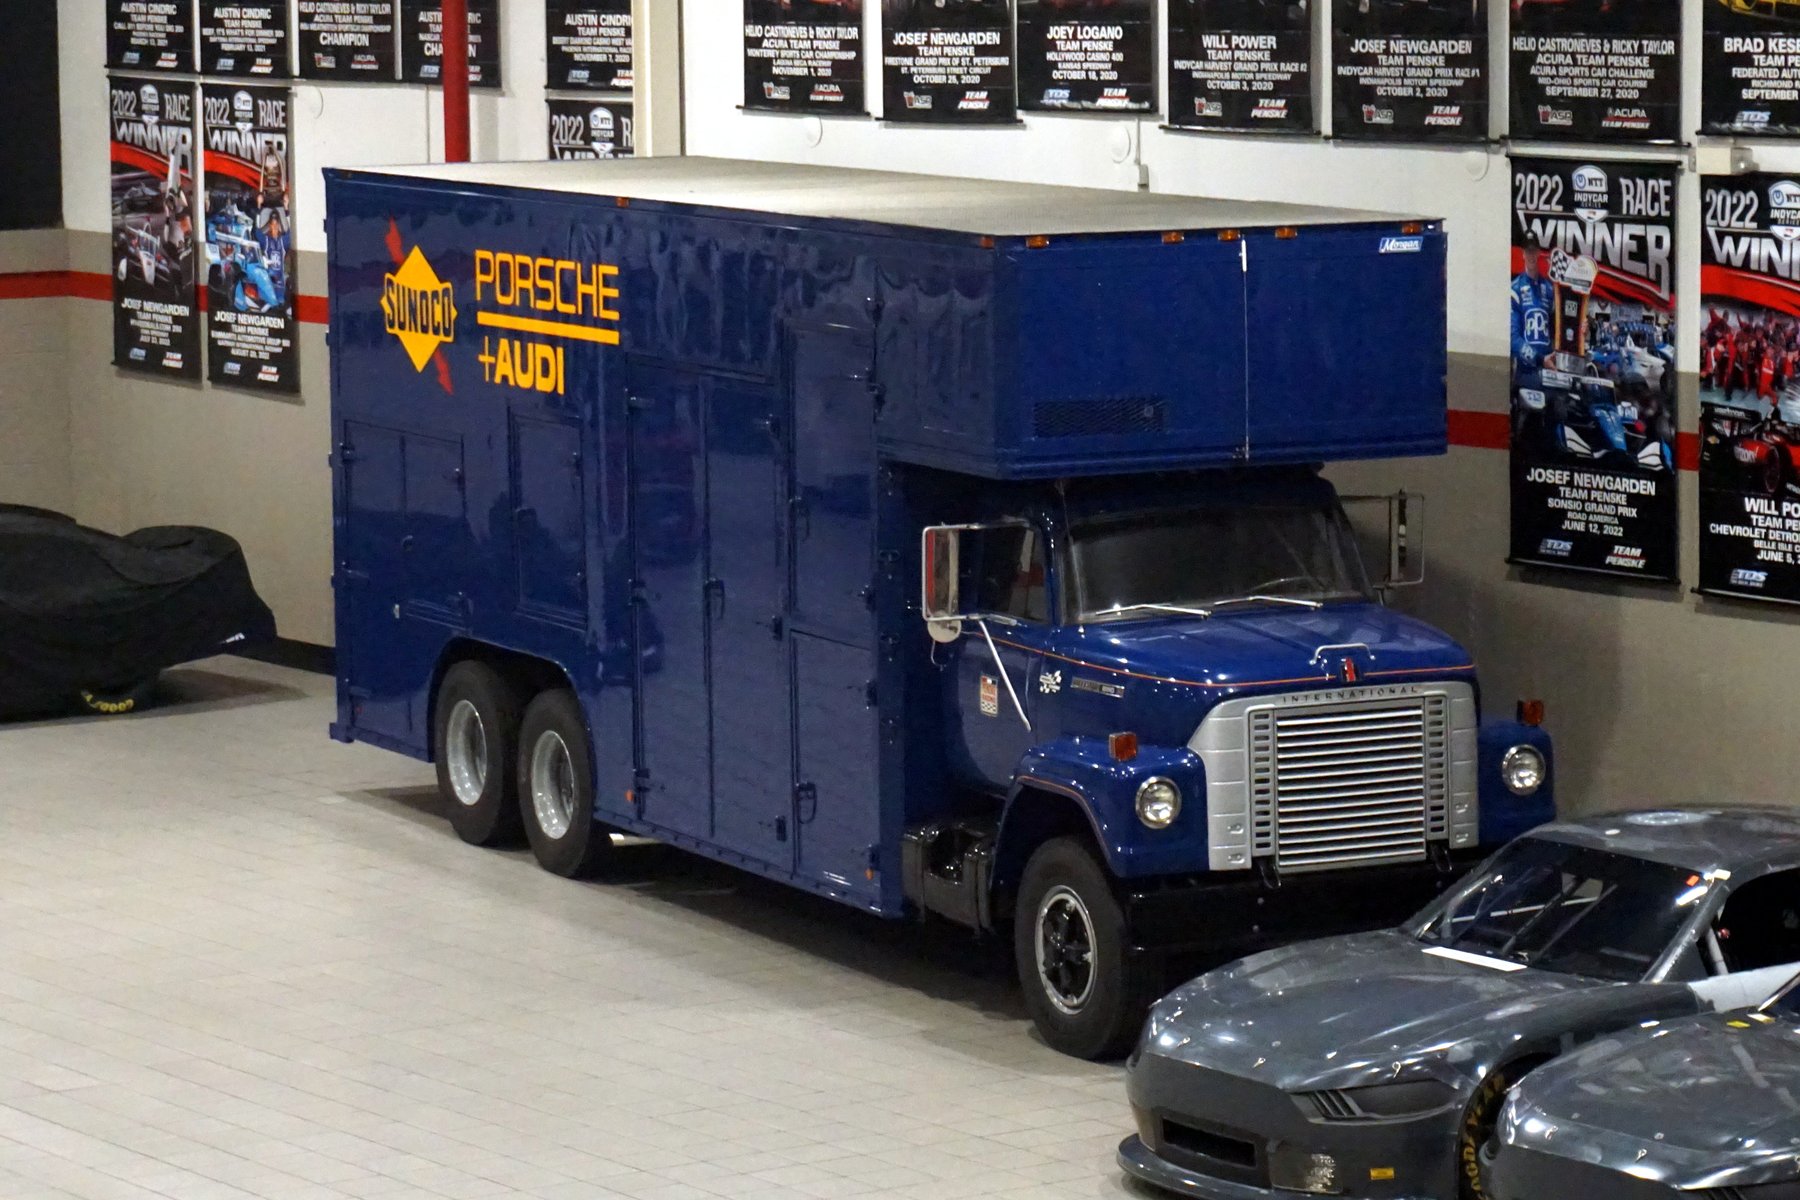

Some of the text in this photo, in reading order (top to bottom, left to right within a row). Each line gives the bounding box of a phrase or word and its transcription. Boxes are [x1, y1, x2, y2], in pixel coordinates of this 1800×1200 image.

[214, 7, 272, 19] AUSTIN CINDRIC
[565, 14, 597, 25] AUSTIN
[577, 27, 625, 37] TEAM PENSKE
[815, 26, 836, 39] RICKY
[893, 31, 1000, 45] JOSEF NEWGARDEN
[1047, 26, 1123, 40] JOEY LOGANO
[320, 32, 369, 46] CHAMPION
[762, 39, 840, 50] ACURA TEAM PENSKE
[1202, 35, 1277, 49] WILL POWER
[1724, 37, 1765, 53] BRAD
[917, 46, 975, 56] TEAM PENSKE
[1056, 41, 1113, 51] TEAM PENSKE
[1350, 39, 1472, 54] JOSEF NEWGARDEN
[1513, 37, 1675, 55] HELIO CASTRONEVES & RICKY TAYLOR
[574, 53, 608, 62] NOVEMBER
[801, 50, 814, 59] CAR
[1046, 52, 1124, 62] HOLLYWOOD CASINO 400
[1207, 50, 1270, 61] TEAM PENSKE
[1536, 53, 1650, 67] ACURA TEAM PENSKE
[1753, 55, 1785, 66] TEAM
[915, 57, 937, 66] GRAND
[961, 57, 972, 66] ST.
[1058, 62, 1112, 70] KANSAS SPEEDWAY
[1174, 60, 1299, 72] INDYCAR HARVEST GRAND PRIX RACE
[1377, 55, 1445, 67] TEAM PENSKE
[772, 66, 808, 76] NOVEMBER
[1052, 71, 1118, 80] OCTOBER 2020
[1192, 71, 1230, 79] INDIANAPOLIS
[1231, 72, 1254, 80] MOTOR
[1337, 66, 1373, 76] INDYCAR
[1374, 67, 1404, 77] HARVEST
[1406, 67, 1433, 77] GRAND
[1435, 68, 1453, 77] PRIX
[1455, 68, 1471, 78] RACE
[1530, 65, 1655, 79] ACURA SPORTS CAR CHALLENGE
[1732, 68, 1779, 79] FEDERATED
[913, 75, 980, 84] OCTOBER 2020
[1359, 77, 1465, 87] INDIANAPOLIS MOTOR SPEEDWAY
[1537, 77, 1648, 89] MID-OHIO SPORTS CAR COURSE
[1752, 80, 1793, 89] RICHMOND
[1103, 88, 1127, 96] TEAM
[1207, 80, 1274, 92] OCTOBER 3, 2020
[1376, 86, 1448, 98] OCTOBER 2, 2020
[1545, 86, 1640, 100] SEPTEMBER 27, 2020
[1742, 89, 1798, 100] SEPTEMBER
[112, 89, 191, 122] 2022 RACE
[1258, 98, 1286, 108] TEAM
[205, 97, 286, 128] 2022 RACE
[1251, 109, 1288, 118] PENSKE
[1432, 106, 1460, 115] TEAM
[1614, 109, 1647, 118] ACURA
[1742, 111, 1771, 122] TDS
[1424, 116, 1463, 126] PENSKE
[552, 115, 584, 145] 2022
[1515, 173, 1672, 217] 2022 RACE
[1574, 192, 1608, 203] INDYCAR
[1706, 188, 1759, 229] 2022
[1517, 210, 1671, 301] WINNER
[475, 249, 620, 321] PORSCHE
[143, 301, 189, 317] NEWGARDEN
[387, 279, 452, 338] SUNOCO
[215, 311, 284, 329] JOSEF NEWGARDEN
[1527, 467, 1656, 496] JOSEF NEWGARDEN
[1559, 487, 1627, 505] TEAM PENSKE
[1548, 498, 1637, 518] SONSIO GRAND PRIX
[1744, 497, 1779, 515] WILL
[1567, 511, 1619, 525] ROAD AMERICA
[1751, 515, 1782, 529] TEAM
[1562, 520, 1623, 537] JUNE 12, 2022
[1710, 523, 1766, 539] CHEVROLET
[1613, 545, 1642, 557] TEAM
[1754, 540, 1792, 552] BELLE ISLE
[1757, 550, 1783, 562] JUNE
[1606, 556, 1646, 569] PENSKE
[1737, 569, 1768, 582] TDS
[1283, 687, 1419, 703] INTERNATIONAL
